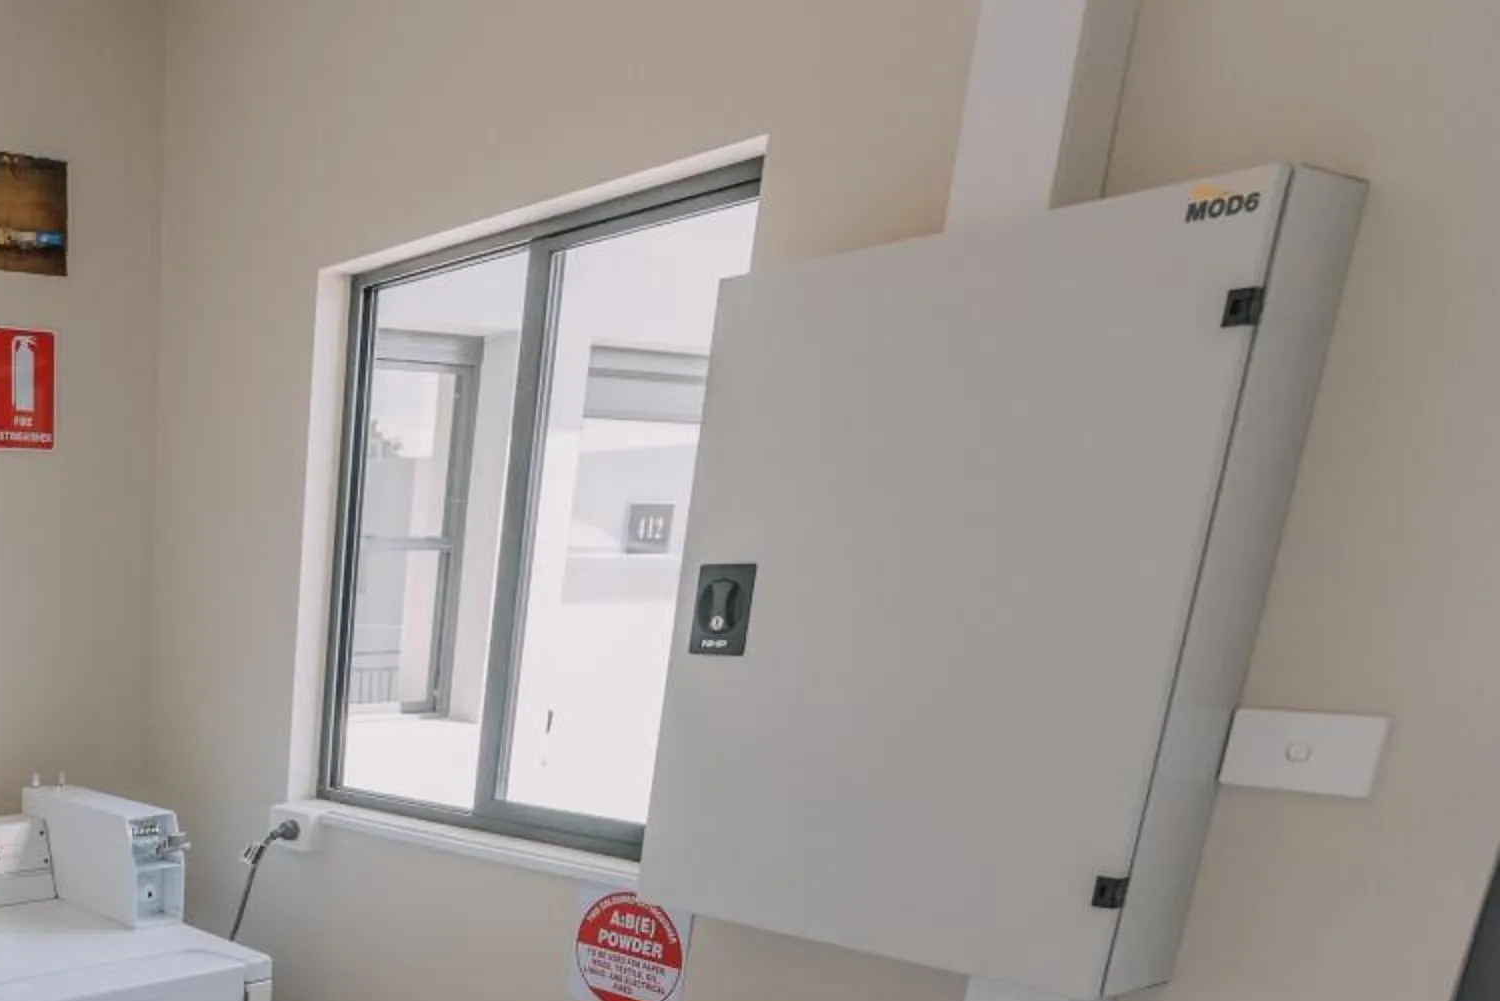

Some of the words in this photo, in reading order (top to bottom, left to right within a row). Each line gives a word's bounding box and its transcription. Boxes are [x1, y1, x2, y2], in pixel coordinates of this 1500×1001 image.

[1185, 192, 1261, 223] MOD6
[13, 415, 32, 427] FIRE
[598, 928, 664, 959] POWDER
